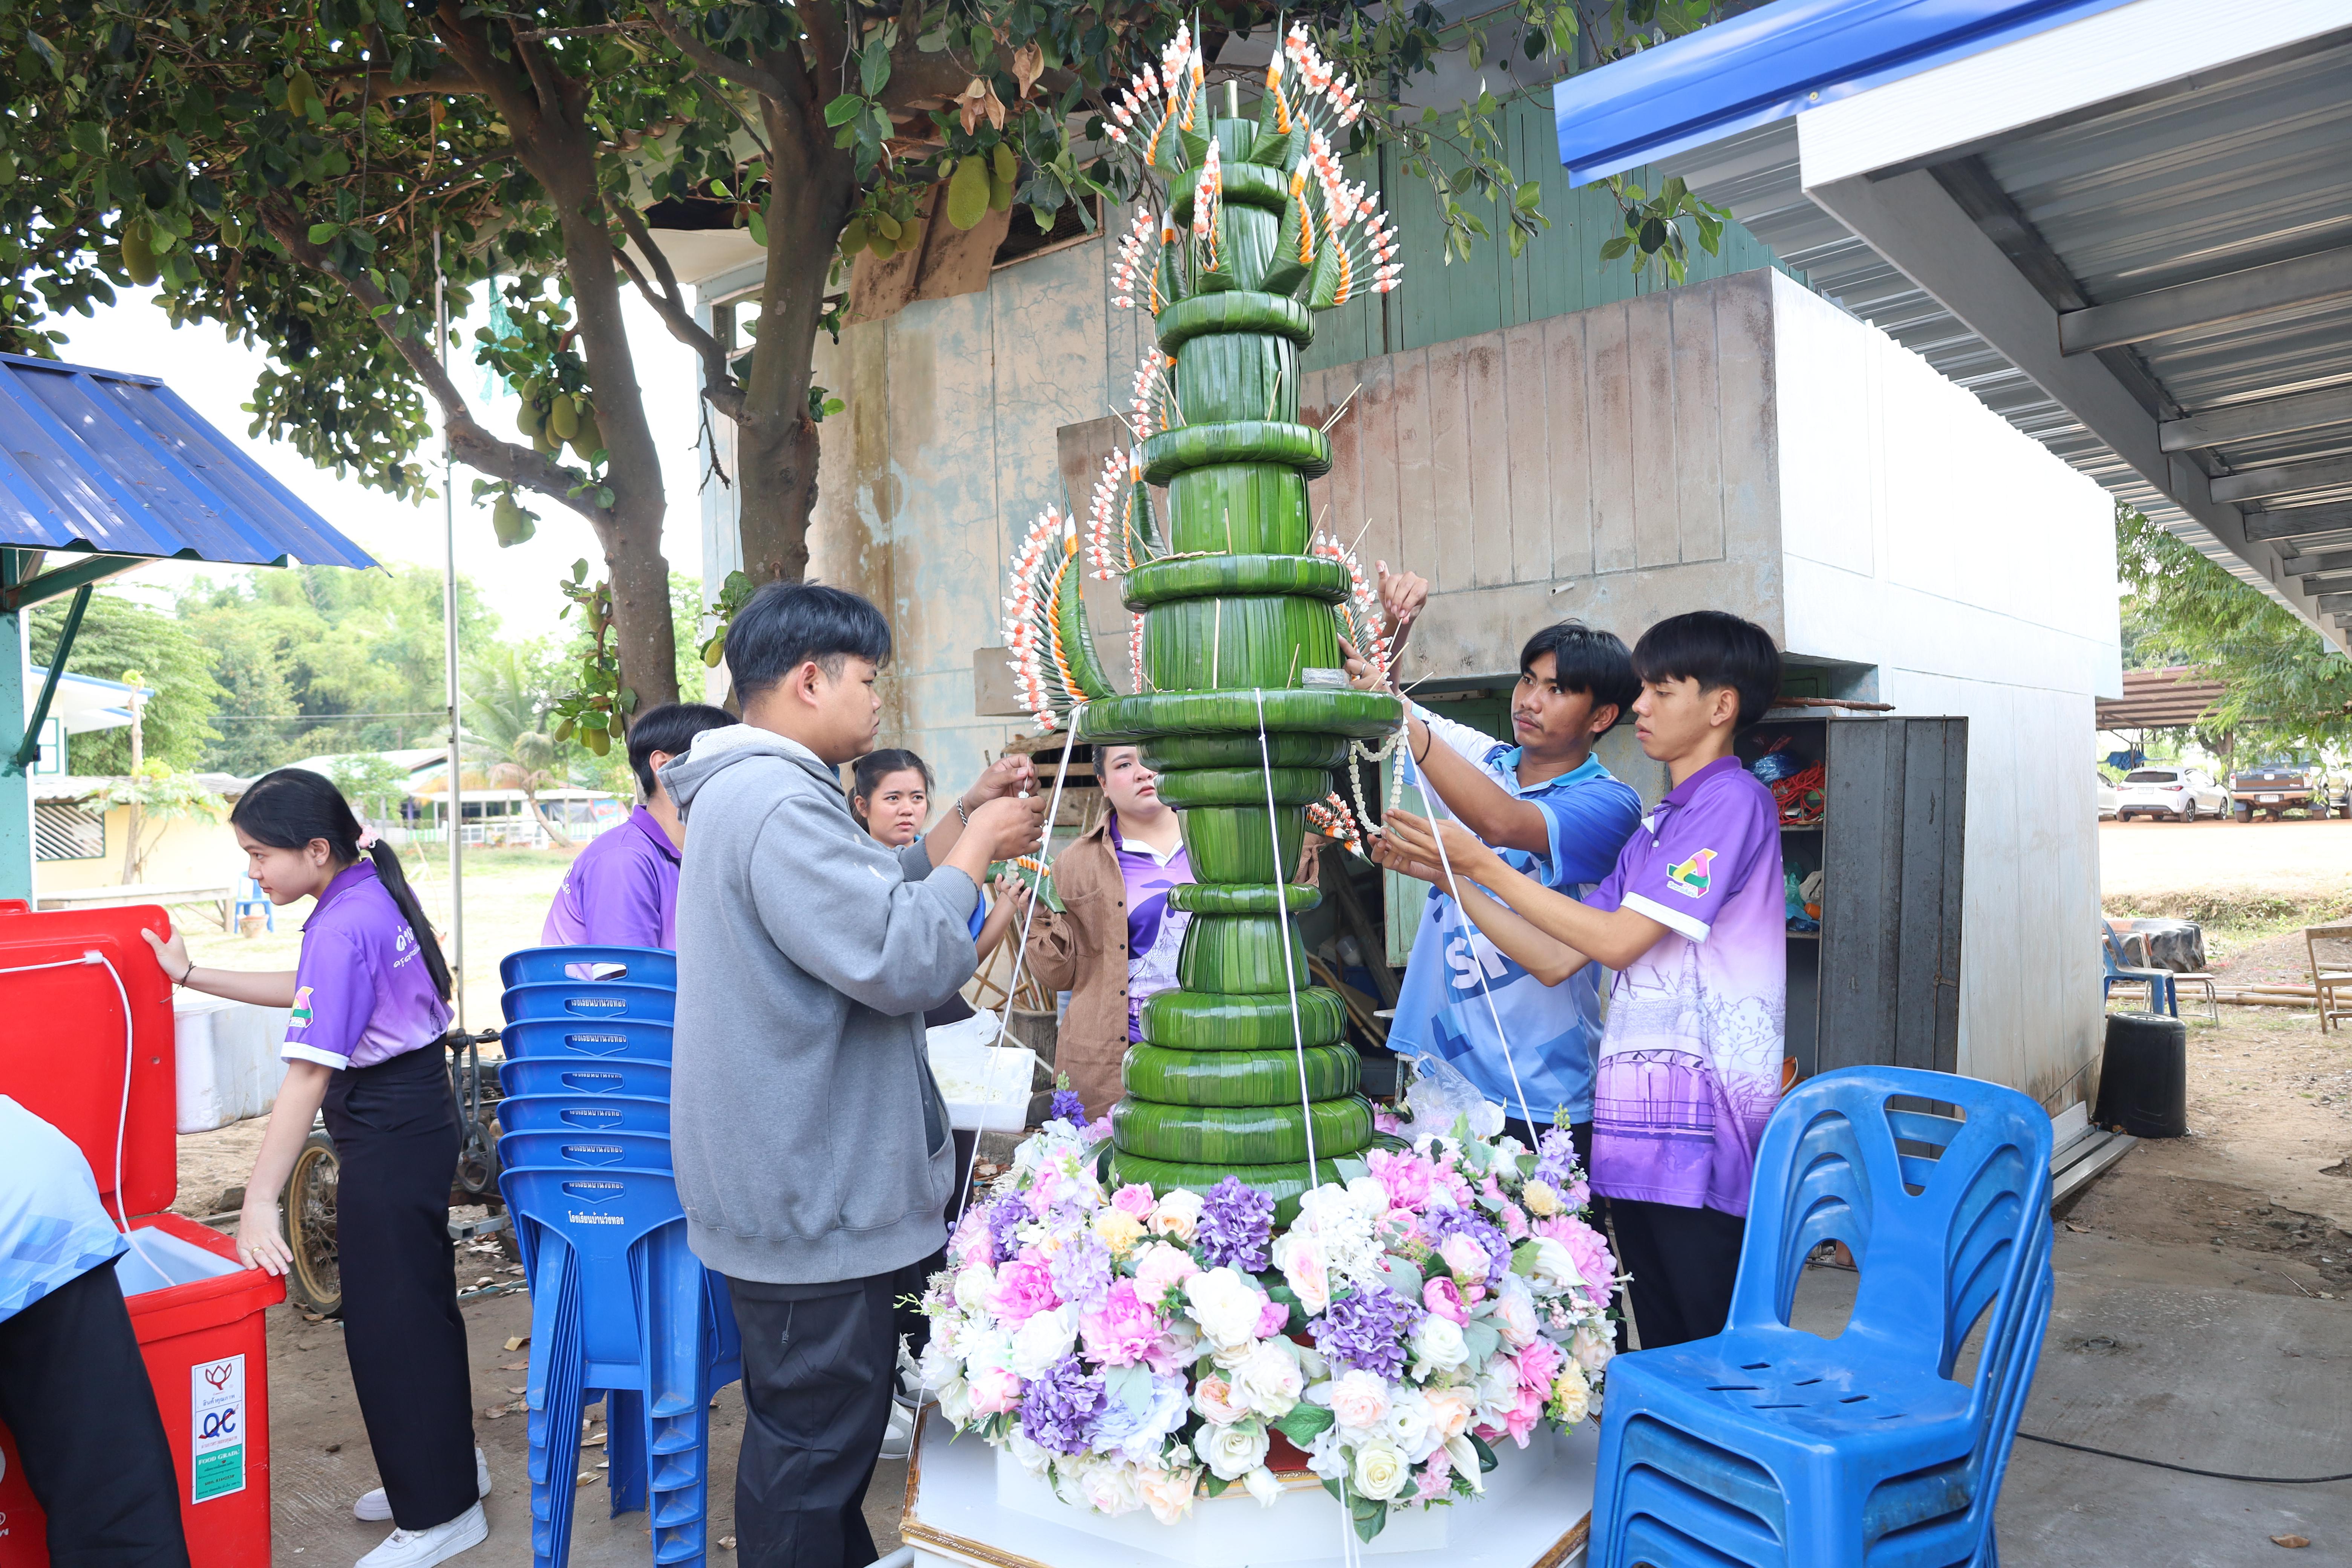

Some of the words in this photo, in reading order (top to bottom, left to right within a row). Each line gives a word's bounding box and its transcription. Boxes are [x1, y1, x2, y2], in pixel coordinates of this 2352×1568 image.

[568, 1210, 624, 1225] โรงเรียนบ้านวังทอง
[203, 1395, 235, 1406] สินค้าคุณภาพ
[204, 1408, 236, 1437] QC
[198, 1456, 216, 1465] FOOD
[217, 1449, 240, 1459] GRADE
